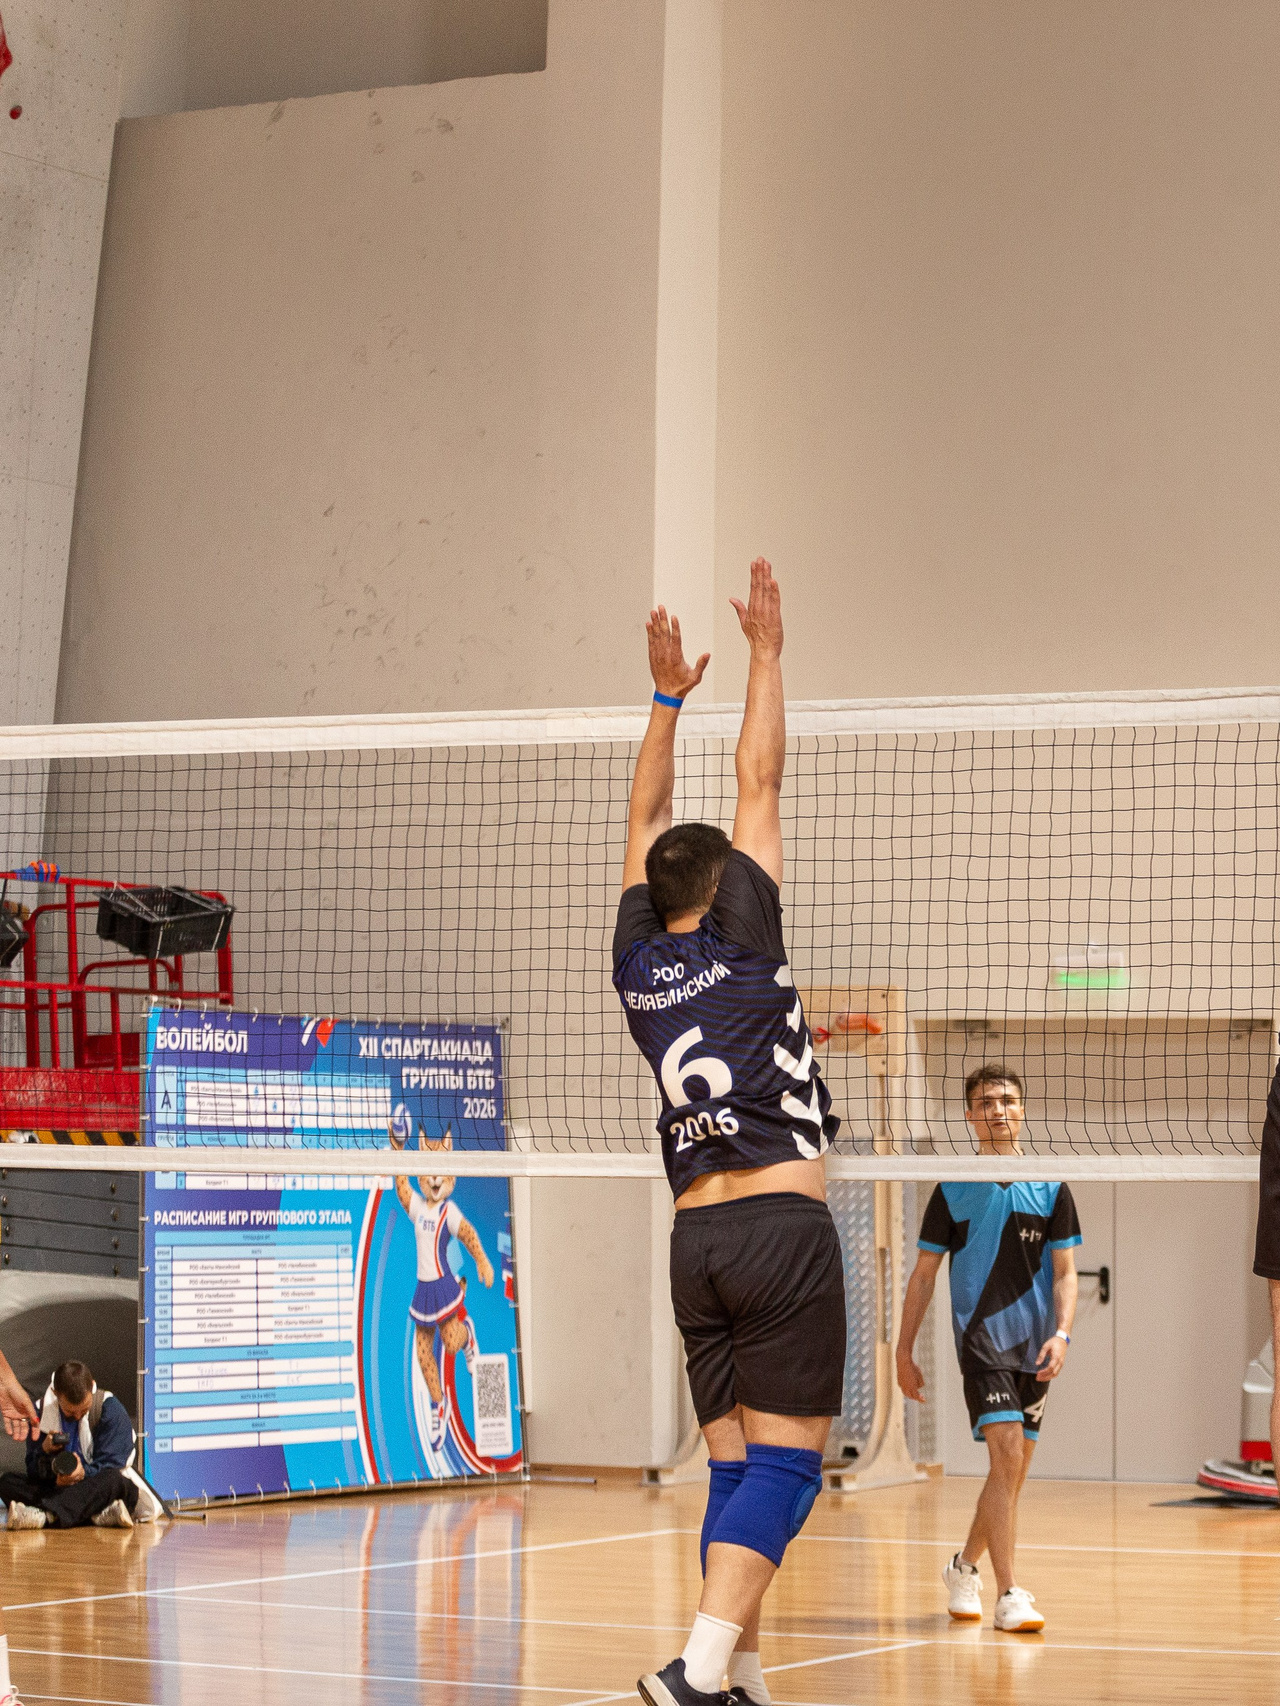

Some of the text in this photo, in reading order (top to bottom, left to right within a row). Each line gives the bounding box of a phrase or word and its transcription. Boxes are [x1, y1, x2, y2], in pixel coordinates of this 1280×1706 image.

[623, 960, 732, 1011] ЧЕЛЯБИНСКИЙ
[156, 1023, 249, 1054] ВОЛЕЙБОЛ
[381, 1037, 495, 1065] СПАРТАКИАДА
[402, 1066, 496, 1091] ГРУППЫ ВТБ
[660, 1025, 733, 1109] 6
[463, 1097, 497, 1119] 2026
[154, 1209, 352, 1226] РАСПИСАНИЕ ИГР ГРУППОВОГО ЭТАПА
[1023, 1393, 1047, 1423] 4
